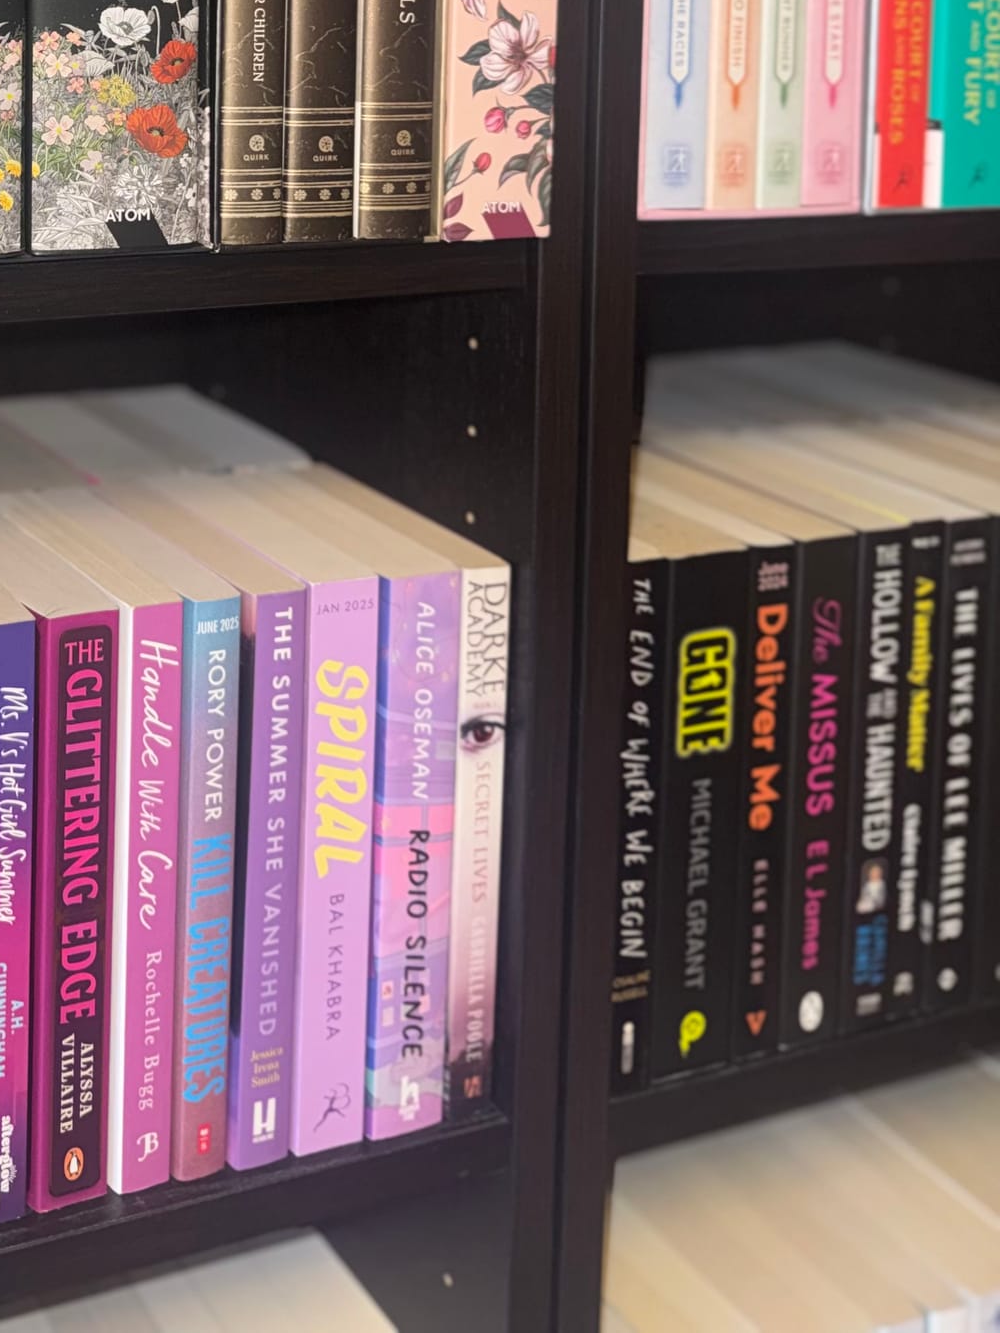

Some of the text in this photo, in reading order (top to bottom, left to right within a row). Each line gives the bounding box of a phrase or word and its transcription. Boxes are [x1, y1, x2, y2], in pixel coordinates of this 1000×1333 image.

[251, 7, 268, 82] CHILDREN
[105, 207, 151, 225] ATOM
[482, 201, 522, 215] ATOM
[64, 638, 106, 665] THE
[464, 582, 486, 698] ACADEMY
[483, 582, 508, 695] DARKE
[633, 579, 654, 615] THE
[411, 602, 436, 799] ALICE OSEMAN
[629, 630, 655, 686] END
[629, 701, 648, 725] OF
[680, 636, 728, 752] GONE
[751, 603, 788, 751] Deliver
[805, 597, 842, 815] The MISSUS
[862, 570, 901, 850] HOLLOW HAUNTED
[136, 639, 174, 930] Handle With Care
[203, 650, 226, 822] RORY POWER
[313, 659, 370, 878] SPIRAL
[621, 739, 654, 816] WHERE
[58, 669, 104, 1024] GLITTERING EDGE
[258, 608, 293, 1036] THE SUMMER SHE VANISHED
[624, 830, 647, 865] WE
[749, 765, 780, 830] Me
[182, 833, 231, 1103] KILL CREATURES
[401, 829, 431, 1058] RADIO SILENCE
[619, 880, 647, 957] BEGIN
[58, 1034, 75, 1133] VILLAIRE
[77, 1042, 94, 1117] ALYSSA
[137, 950, 163, 1110] Rochelle Bugg
